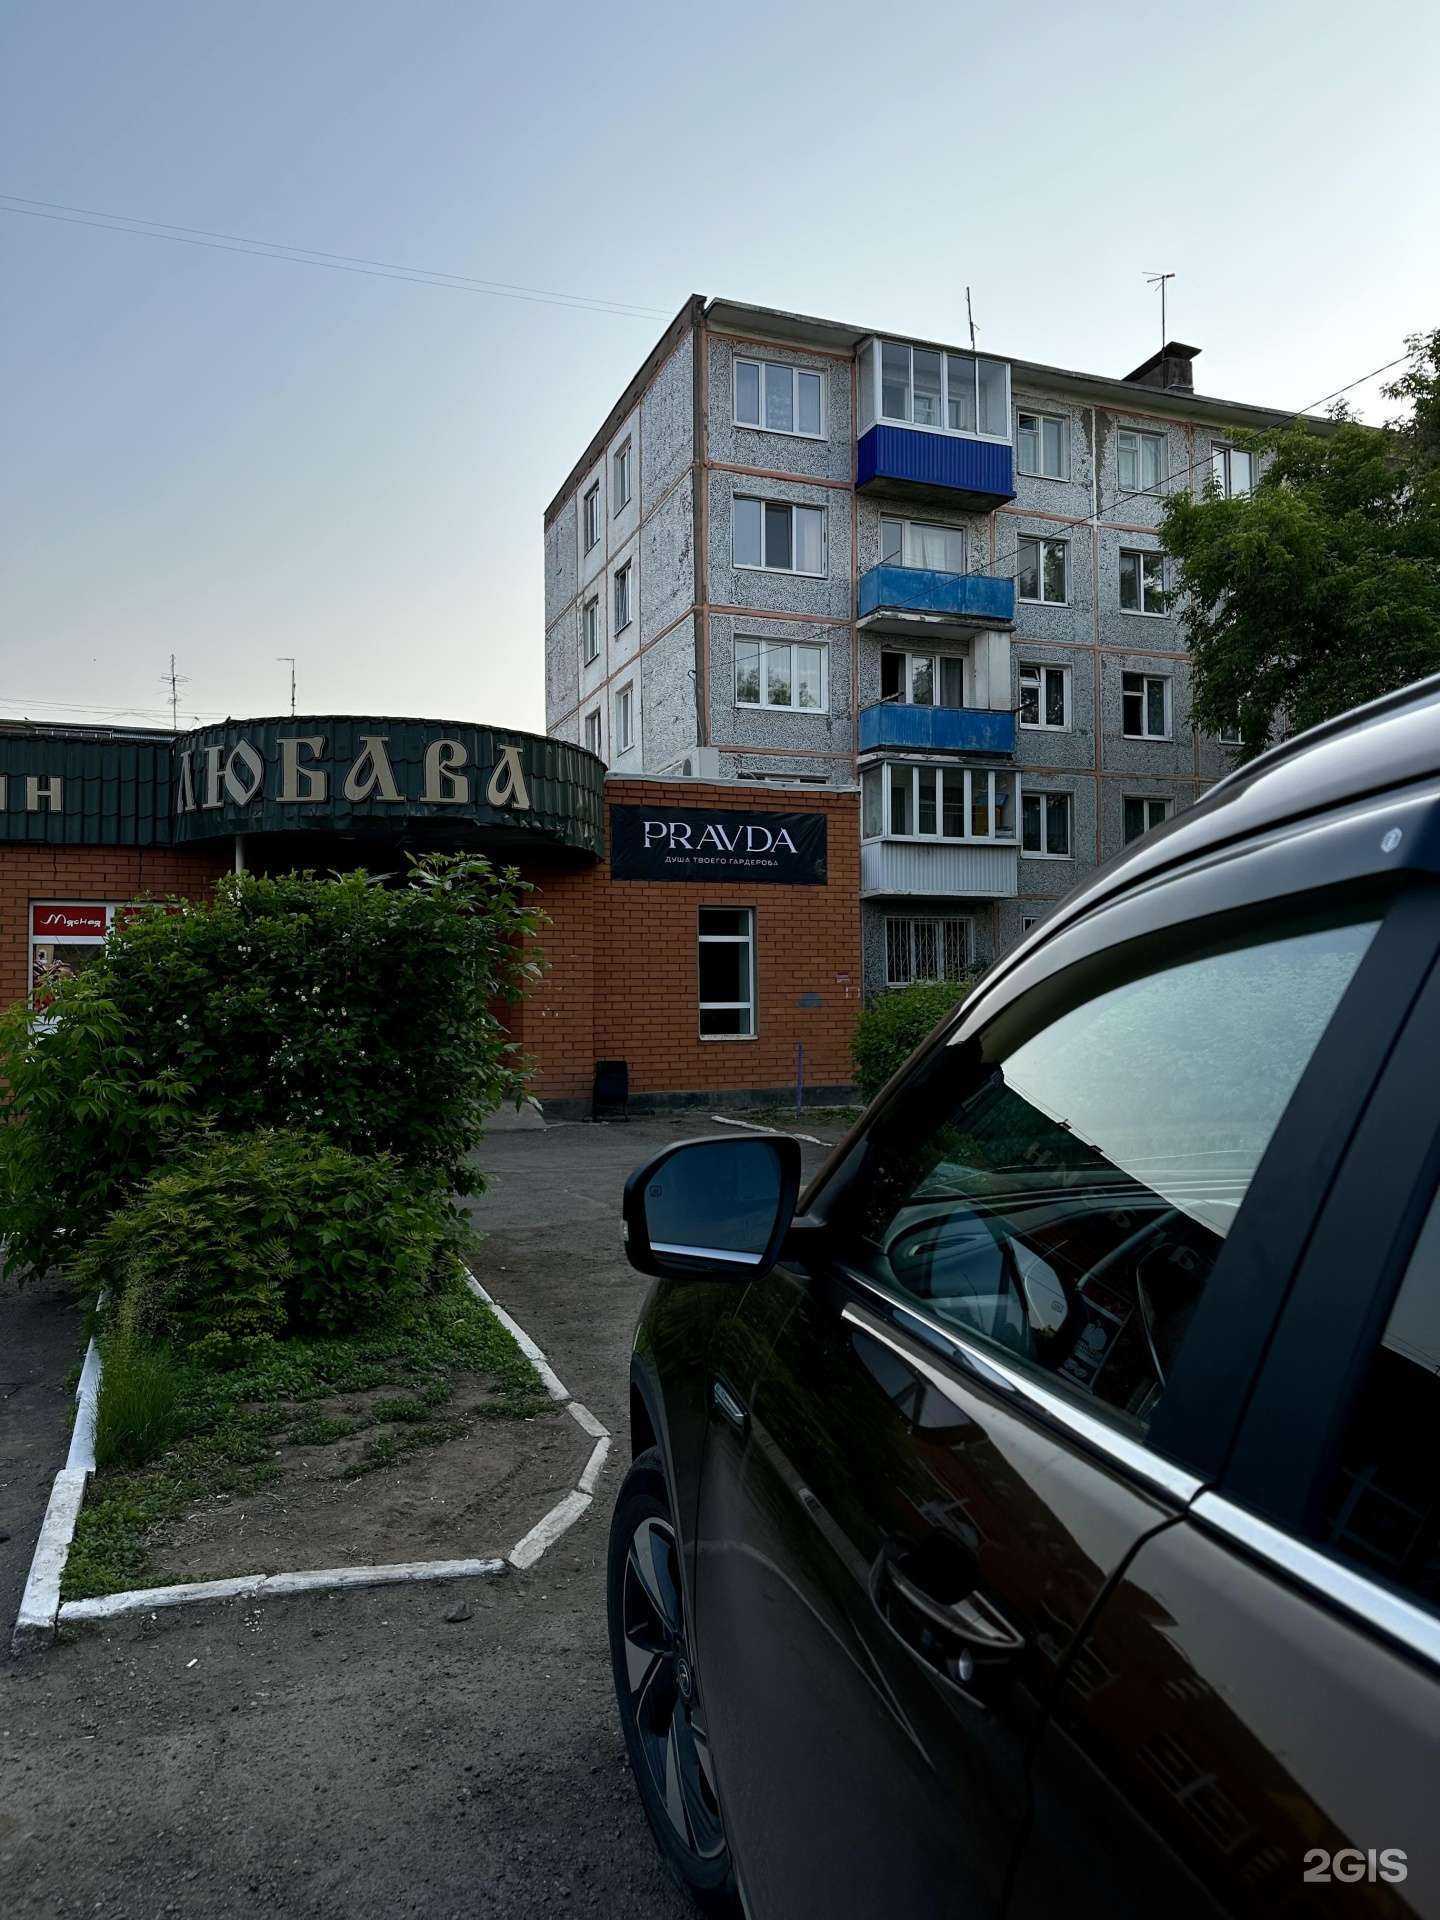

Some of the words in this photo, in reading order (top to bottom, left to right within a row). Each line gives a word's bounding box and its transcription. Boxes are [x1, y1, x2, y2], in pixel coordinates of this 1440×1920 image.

[178, 736, 531, 812] ЛЮБАВА
[642, 820, 799, 854] PRAVDA
[664, 856, 691, 864] ДУША
[693, 856, 727, 865] ТВОЕГО
[729, 857, 779, 866] ГАРДЕРОБА
